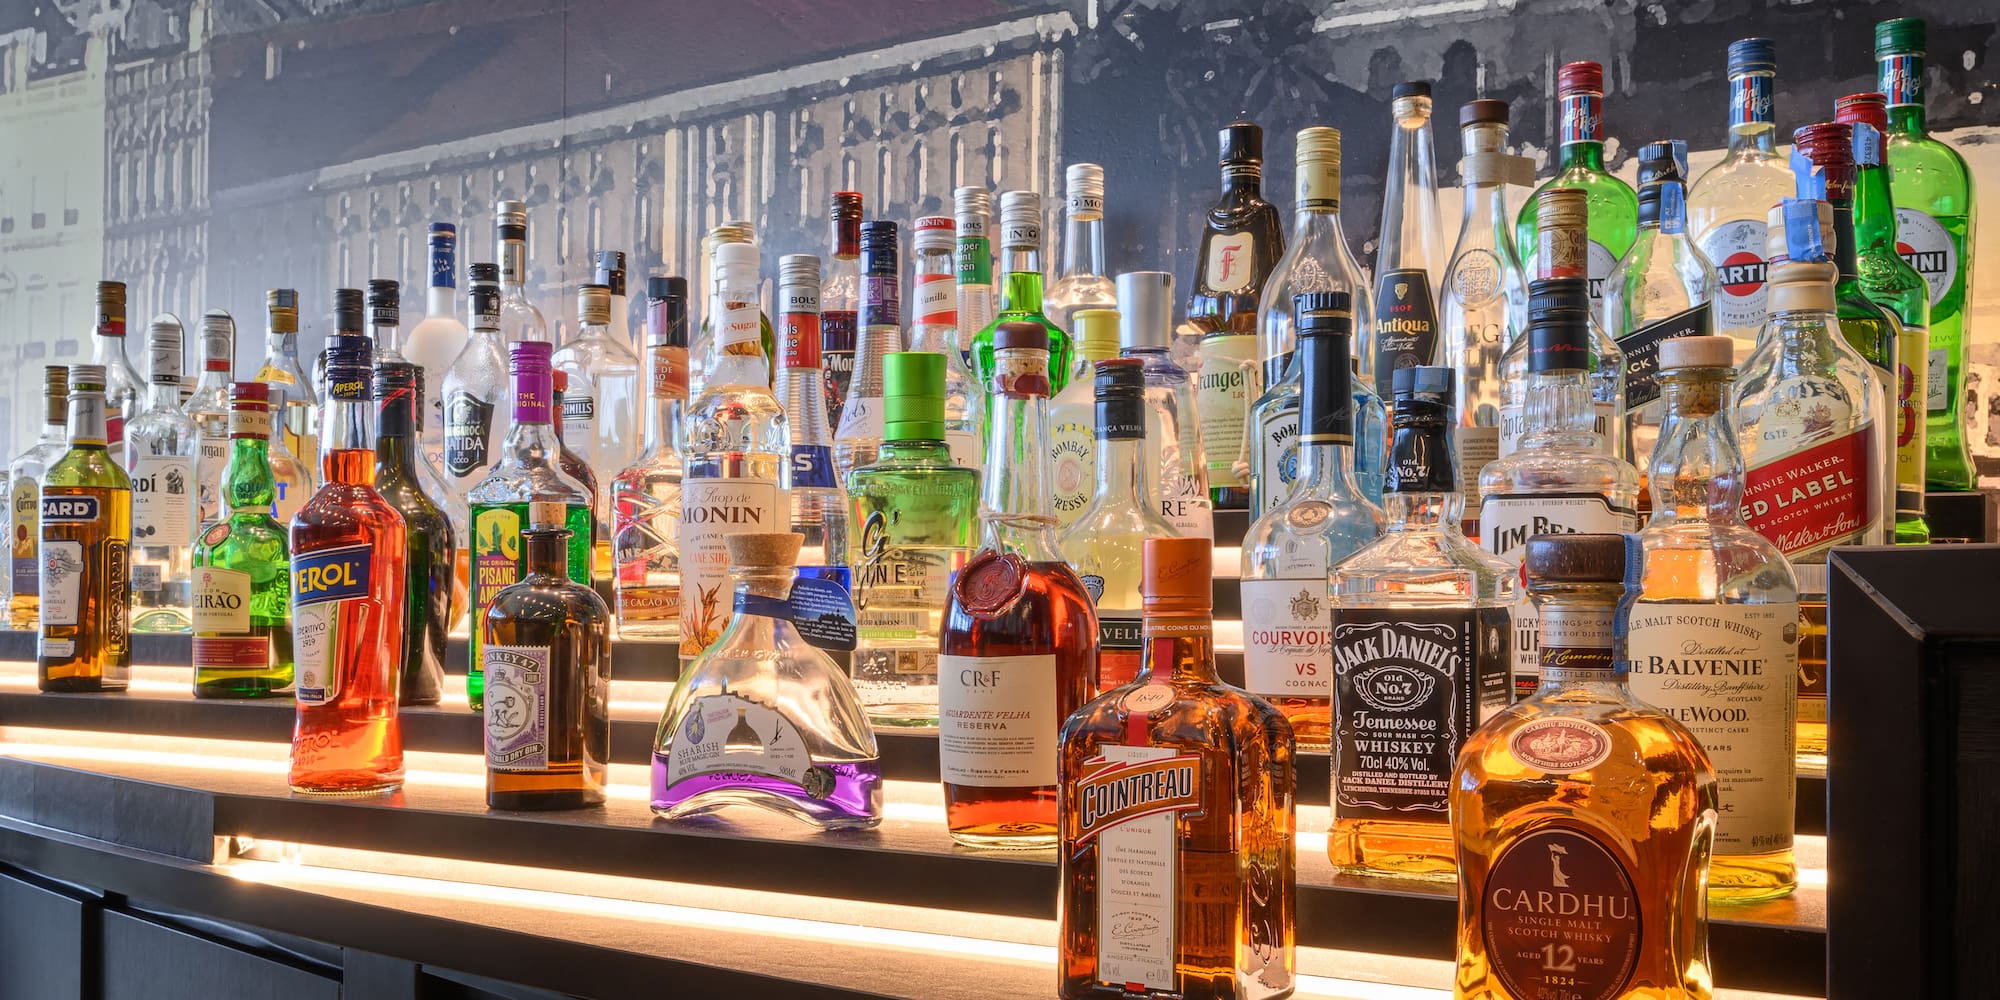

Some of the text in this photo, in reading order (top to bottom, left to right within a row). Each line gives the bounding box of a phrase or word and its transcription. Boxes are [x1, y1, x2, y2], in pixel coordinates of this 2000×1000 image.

[1220, 243, 1243, 282] F
[790, 296, 817, 305] BOLS
[730, 321, 757, 333] Sugar
[332, 380, 365, 396] APEROL
[518, 391, 535, 400] THE
[453, 457, 470, 465] COCO
[1402, 457, 1418, 467] Old
[1785, 454, 1841, 480] WALKER
[1775, 470, 1854, 509] LABEL
[682, 505, 762, 525] MONIN
[1770, 507, 1810, 528] SCOTCH
[1813, 492, 1854, 511] WHISKY
[1493, 515, 1585, 556] JIM BE
[1774, 511, 1861, 551] Walker Sons
[478, 565, 516, 586] PISANG
[854, 564, 908, 585] VINE
[630, 598, 664, 607] CACAO
[1644, 615, 1673, 629] MALT
[1676, 615, 1720, 629] SCOTCH
[1723, 620, 1763, 641] WHISKY
[1334, 628, 1462, 678] JACK DANIEL'S
[1680, 639, 1734, 656] Distilled
[520, 657, 537, 670] 47
[1295, 663, 1317, 676] VS
[1648, 655, 1764, 676] BALVENIE
[960, 669, 1002, 688] CR&F
[1285, 680, 1328, 688] COGNAC
[1383, 674, 1403, 683] Old
[1375, 682, 1413, 696] No.7
[945, 709, 1031, 720] AGUARDENTE VELHA
[1352, 710, 1437, 732] Tennessee
[956, 721, 1008, 731] RESERVA
[1524, 720, 1599, 738] CARDHU DISTILLERY
[1372, 731, 1417, 740] SOUR MASH
[510, 744, 539, 762] DRY GIN
[677, 742, 720, 760] SHARISH
[1354, 740, 1436, 756] WHISKEY
[1701, 744, 1733, 752] YEARS
[679, 755, 693, 766] BLUE
[706, 751, 721, 761] GIN
[1359, 755, 1431, 772] 70cl 40% Vol.
[1520, 750, 1596, 768] MORAYSHIRE SCOTLAND
[1351, 770, 1439, 781] DISTILLED AND BOTTLED BY
[1716, 768, 1743, 776] acquires
[1341, 776, 1450, 789] JACK DANIEL DISTILLERY
[1080, 765, 1193, 829] COINTREAU
[1378, 786, 1413, 795] TENNESSEE
[1430, 788, 1448, 797] U.S.A.
[1120, 826, 1153, 835] L'UNIQUE
[1492, 887, 1630, 920] CARDHU
[1517, 915, 1602, 931] SINGLE MALT
[1507, 926, 1613, 944] SCOTCH WHISKY
[1137, 957, 1164, 966] FRANCE
[1515, 942, 1605, 973] AGED 12 YEARS
[1544, 975, 1576, 986] 1824
